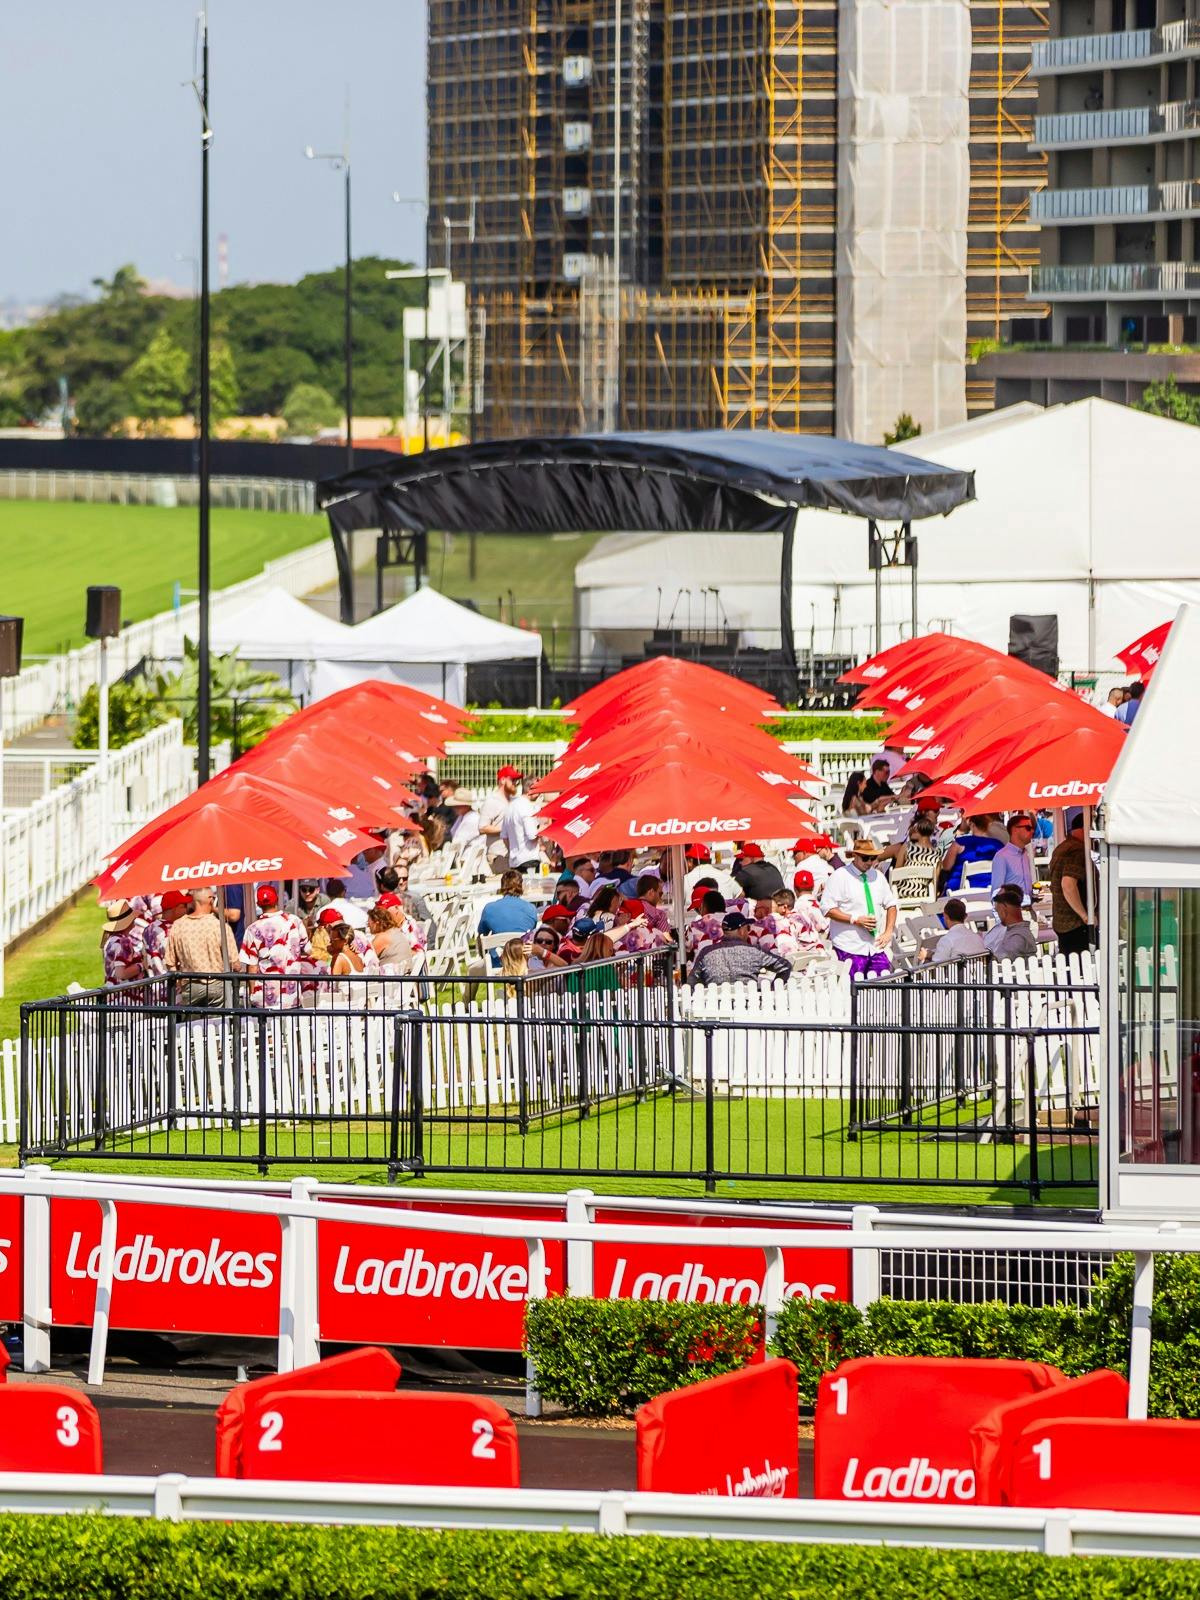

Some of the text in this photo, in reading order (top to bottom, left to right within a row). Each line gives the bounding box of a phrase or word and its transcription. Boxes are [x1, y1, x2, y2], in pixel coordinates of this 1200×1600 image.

[629, 817, 751, 837] Ladbrokes
[161, 857, 283, 882] Ladbrokes
[609, 1258, 836, 1304] Ladbroes
[831, 1378, 847, 1414] 1
[57, 1407, 79, 1446] 3
[259, 1412, 495, 1458] 2 2
[1034, 1439, 1050, 1478] 1
[842, 1458, 975, 1499] Ladbro
